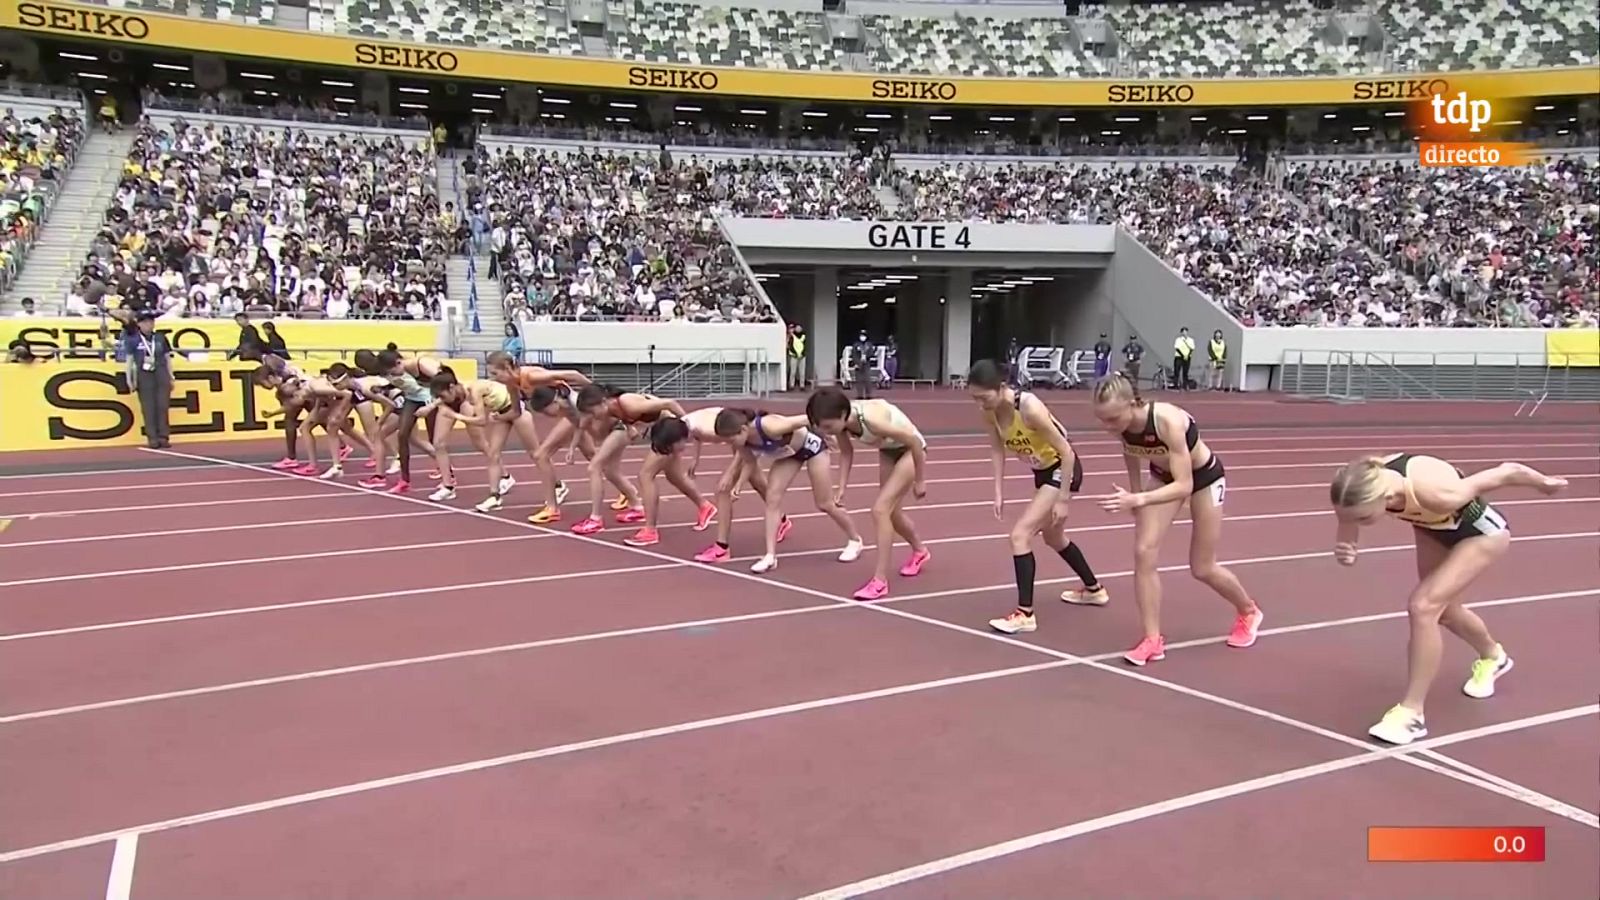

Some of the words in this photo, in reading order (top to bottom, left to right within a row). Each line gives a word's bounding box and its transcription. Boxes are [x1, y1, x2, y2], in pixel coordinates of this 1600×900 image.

[18, 3, 149, 40] SEIKO
[355, 43, 459, 72] SEIKO
[628, 67, 719, 92] SEIKO
[1353, 79, 1449, 99] SEIKO
[873, 80, 956, 102] SEIKO
[1108, 84, 1194, 105] SEIKO
[868, 224, 945, 248] GATE
[955, 226, 971, 248] 4
[808, 437, 819, 448] 5
[1217, 484, 1224, 502] 2
